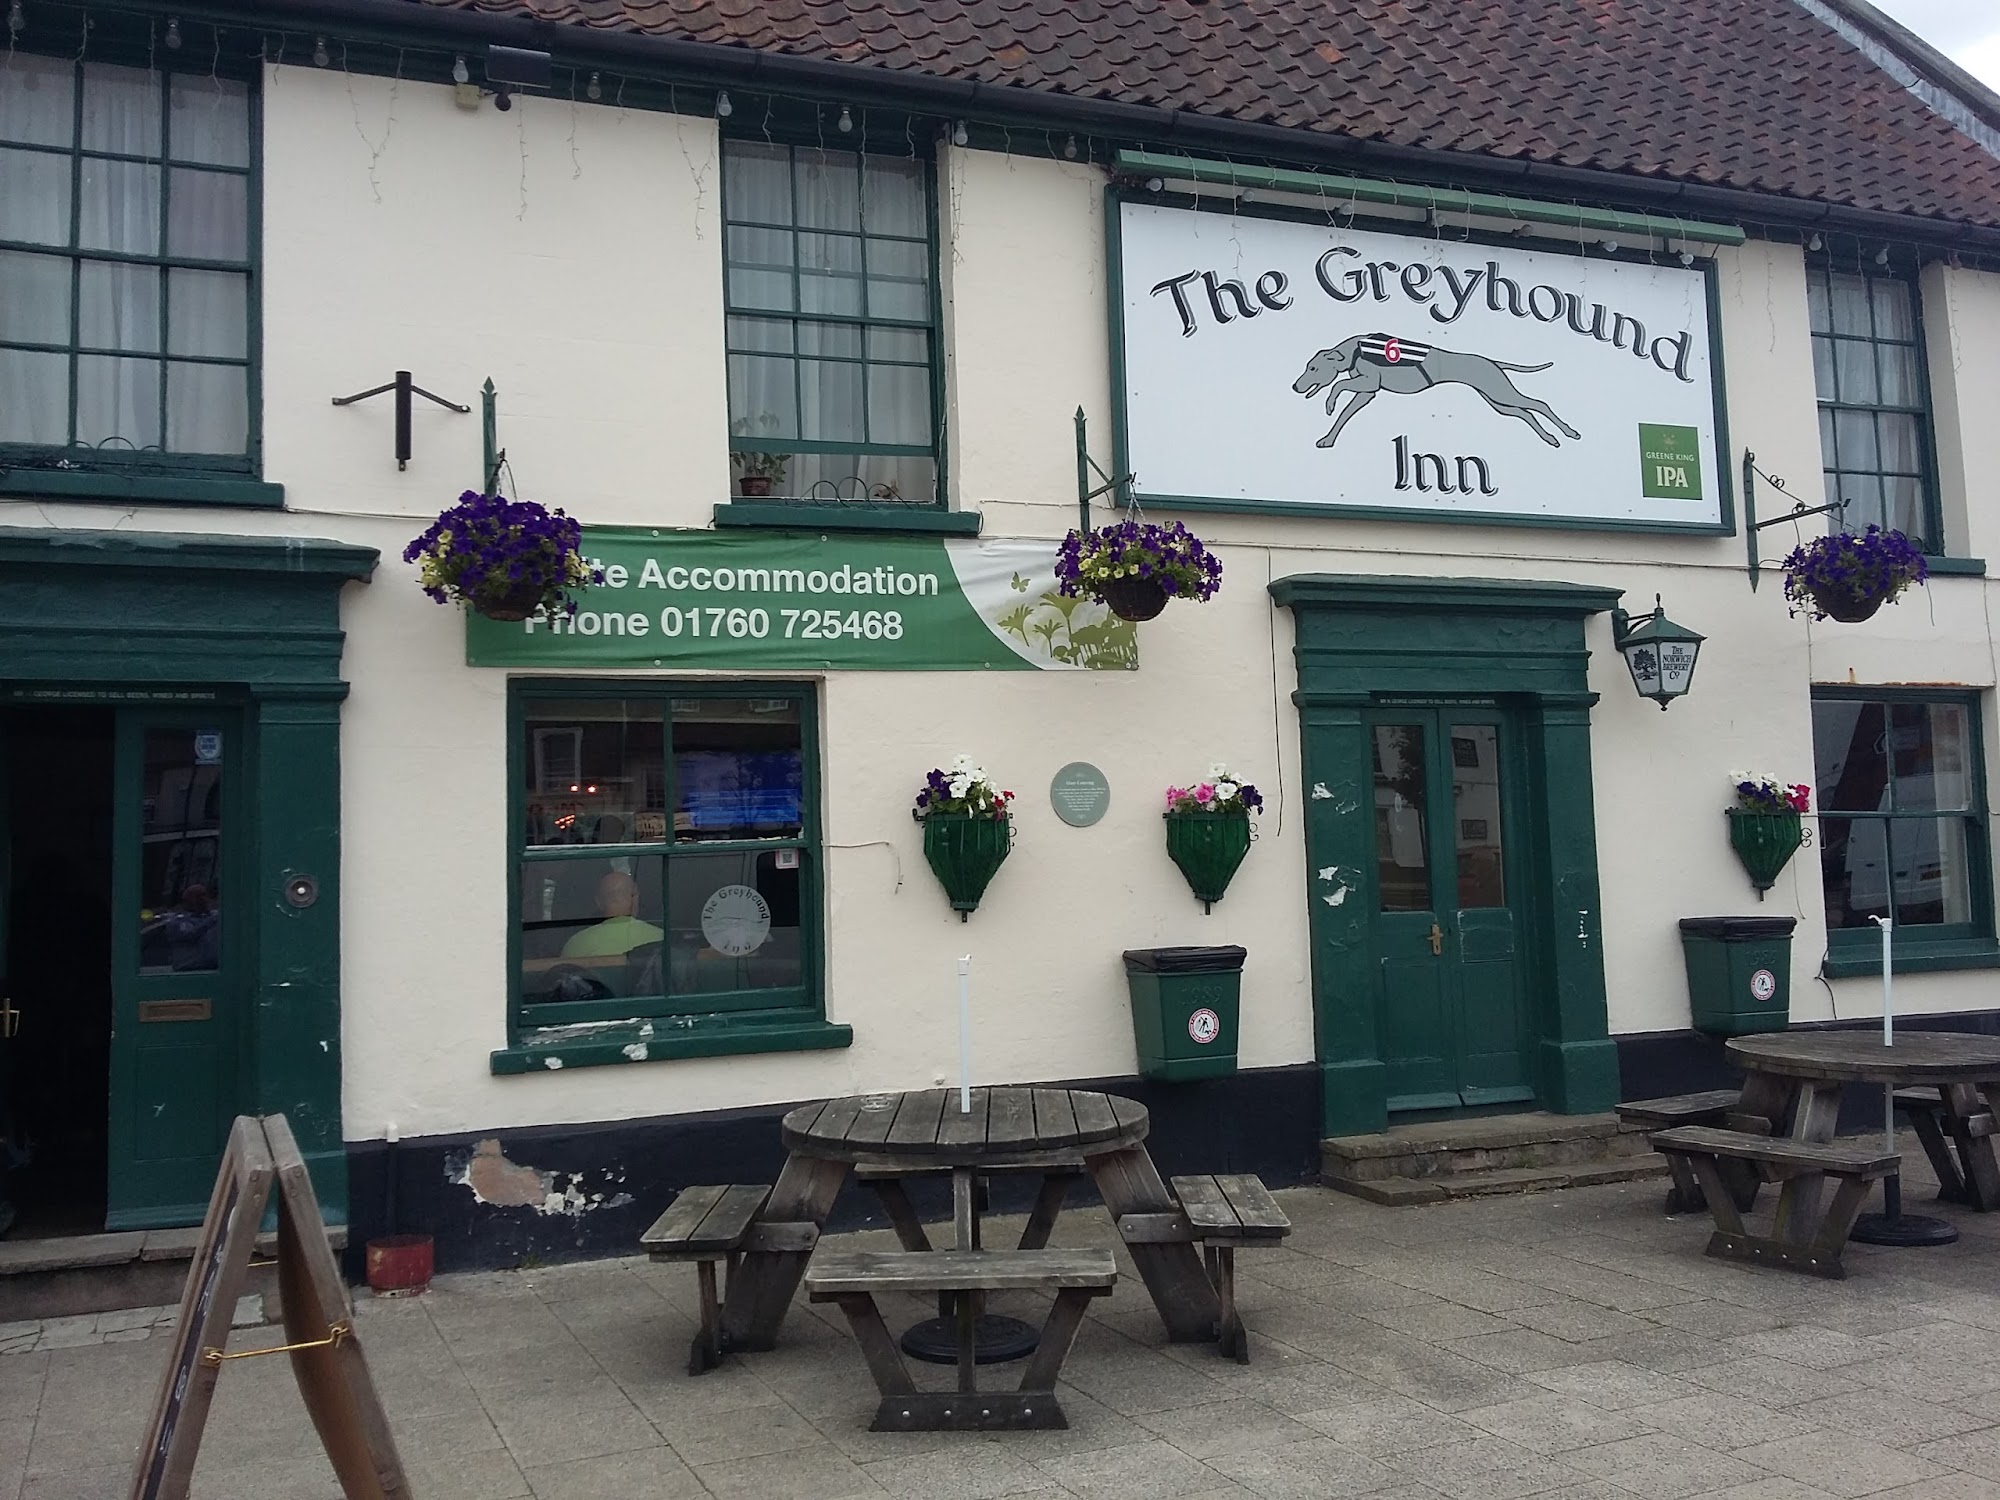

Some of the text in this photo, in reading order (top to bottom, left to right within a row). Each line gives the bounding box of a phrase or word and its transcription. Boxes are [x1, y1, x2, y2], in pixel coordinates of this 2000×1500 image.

[1149, 246, 1696, 383] The Greyhound
[1384, 338, 1401, 363] 6
[1392, 435, 1499, 496] Inn
[1646, 451, 1694, 461] GREENE KING
[1656, 466, 1689, 488] IPA
[637, 558, 939, 597] Accommodation
[525, 603, 904, 641] Phone 01760 725468
[1662, 655, 1692, 663] NORWICH
[703, 888, 770, 921] The Greyhound
